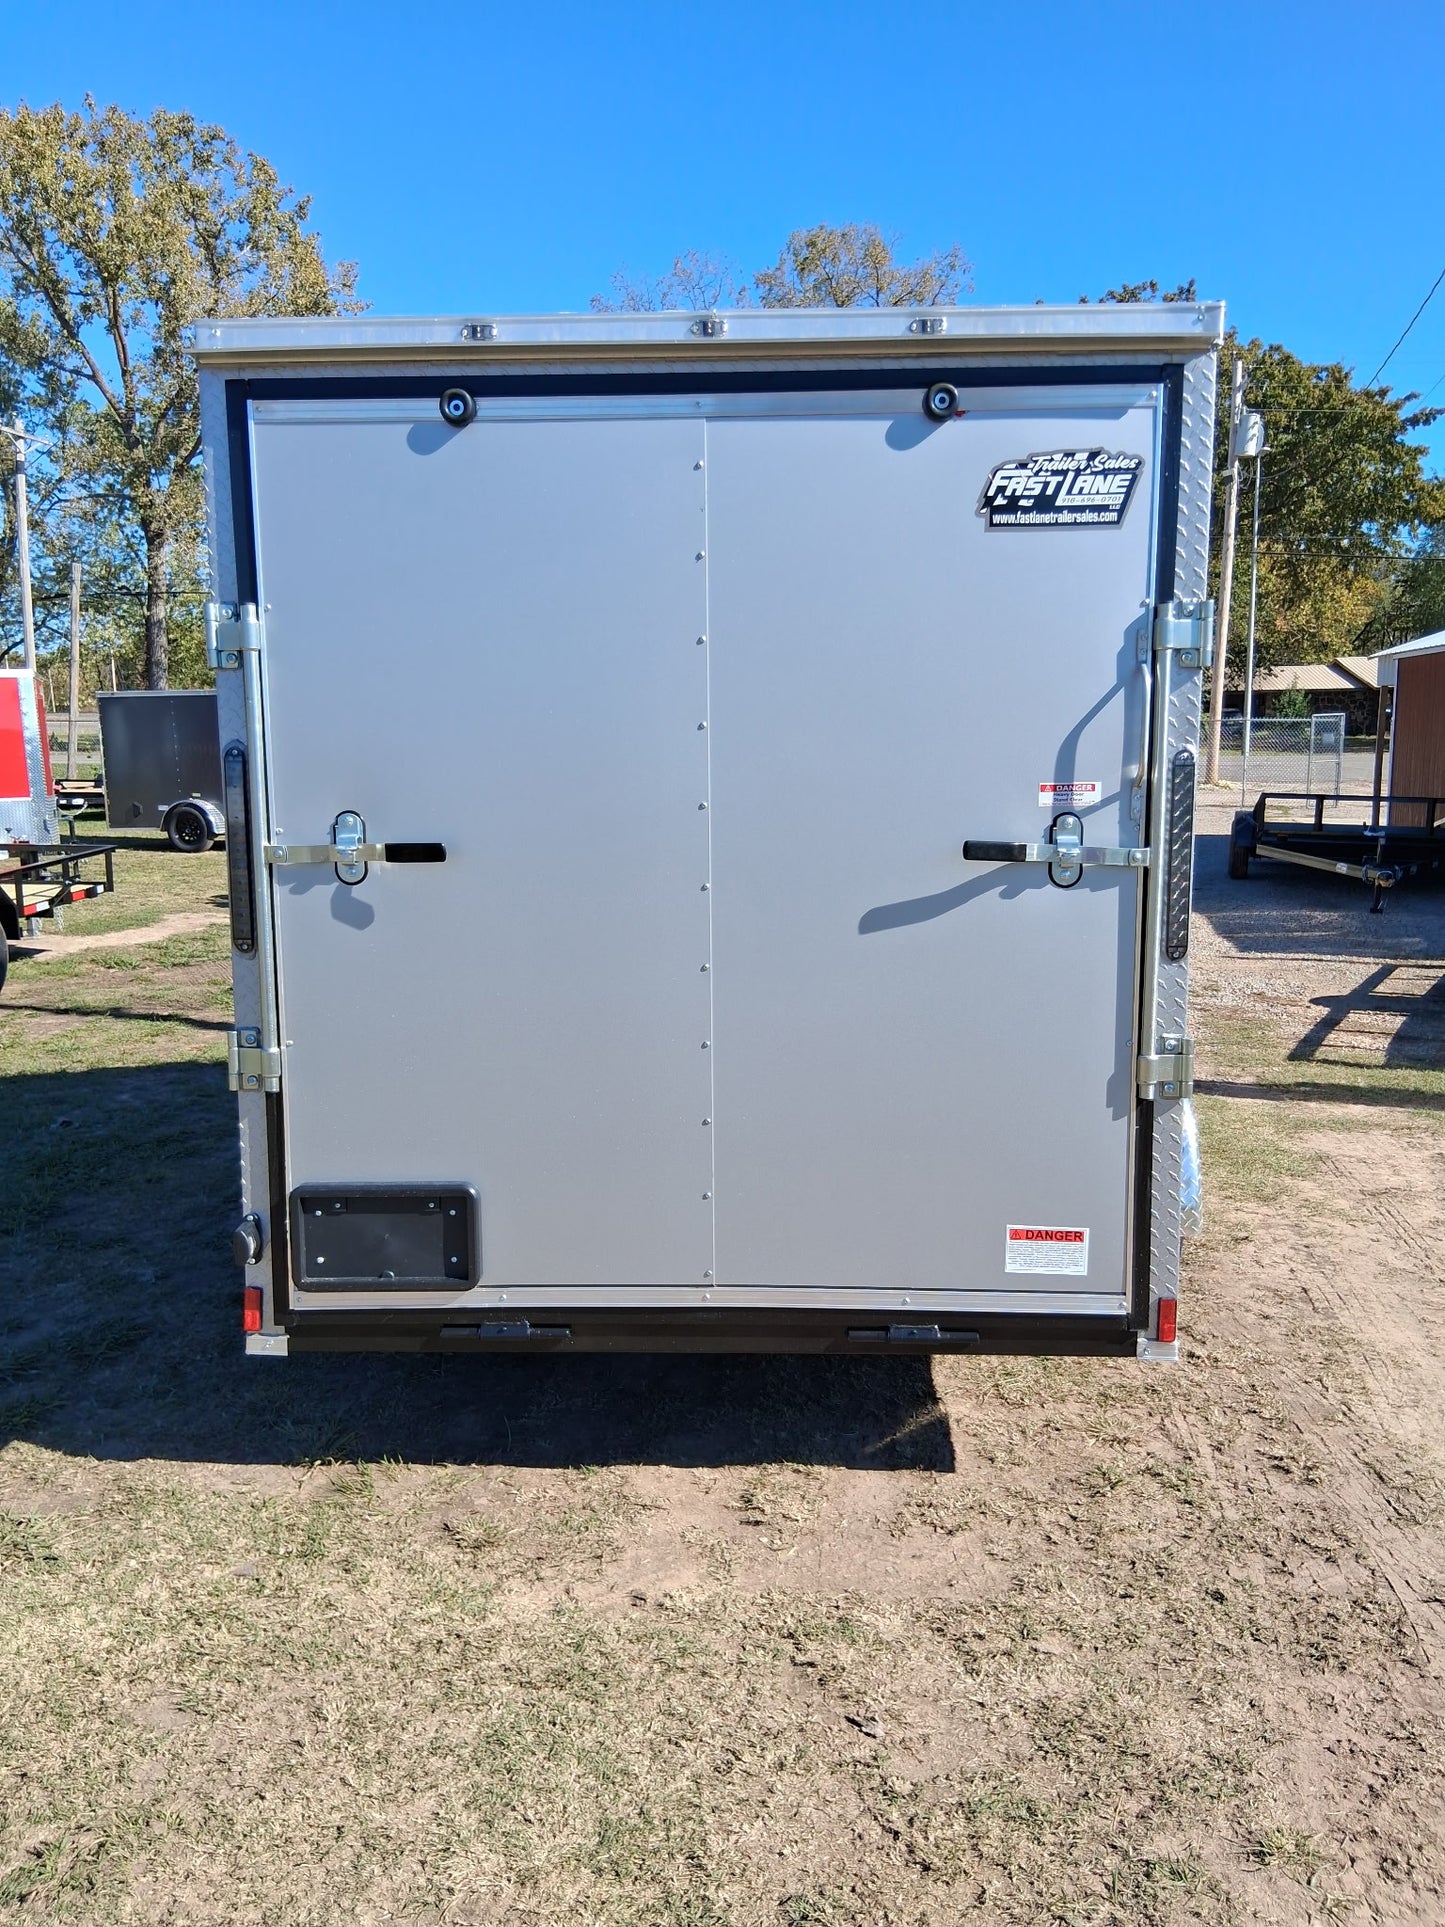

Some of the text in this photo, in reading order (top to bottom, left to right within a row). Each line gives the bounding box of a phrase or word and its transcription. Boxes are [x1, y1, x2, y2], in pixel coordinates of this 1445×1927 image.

[1031, 454, 1139, 472] Trailer Sales
[992, 510, 1118, 524] www.fastlanetrailersales.com
[1025, 1230, 1083, 1241] DANGER
